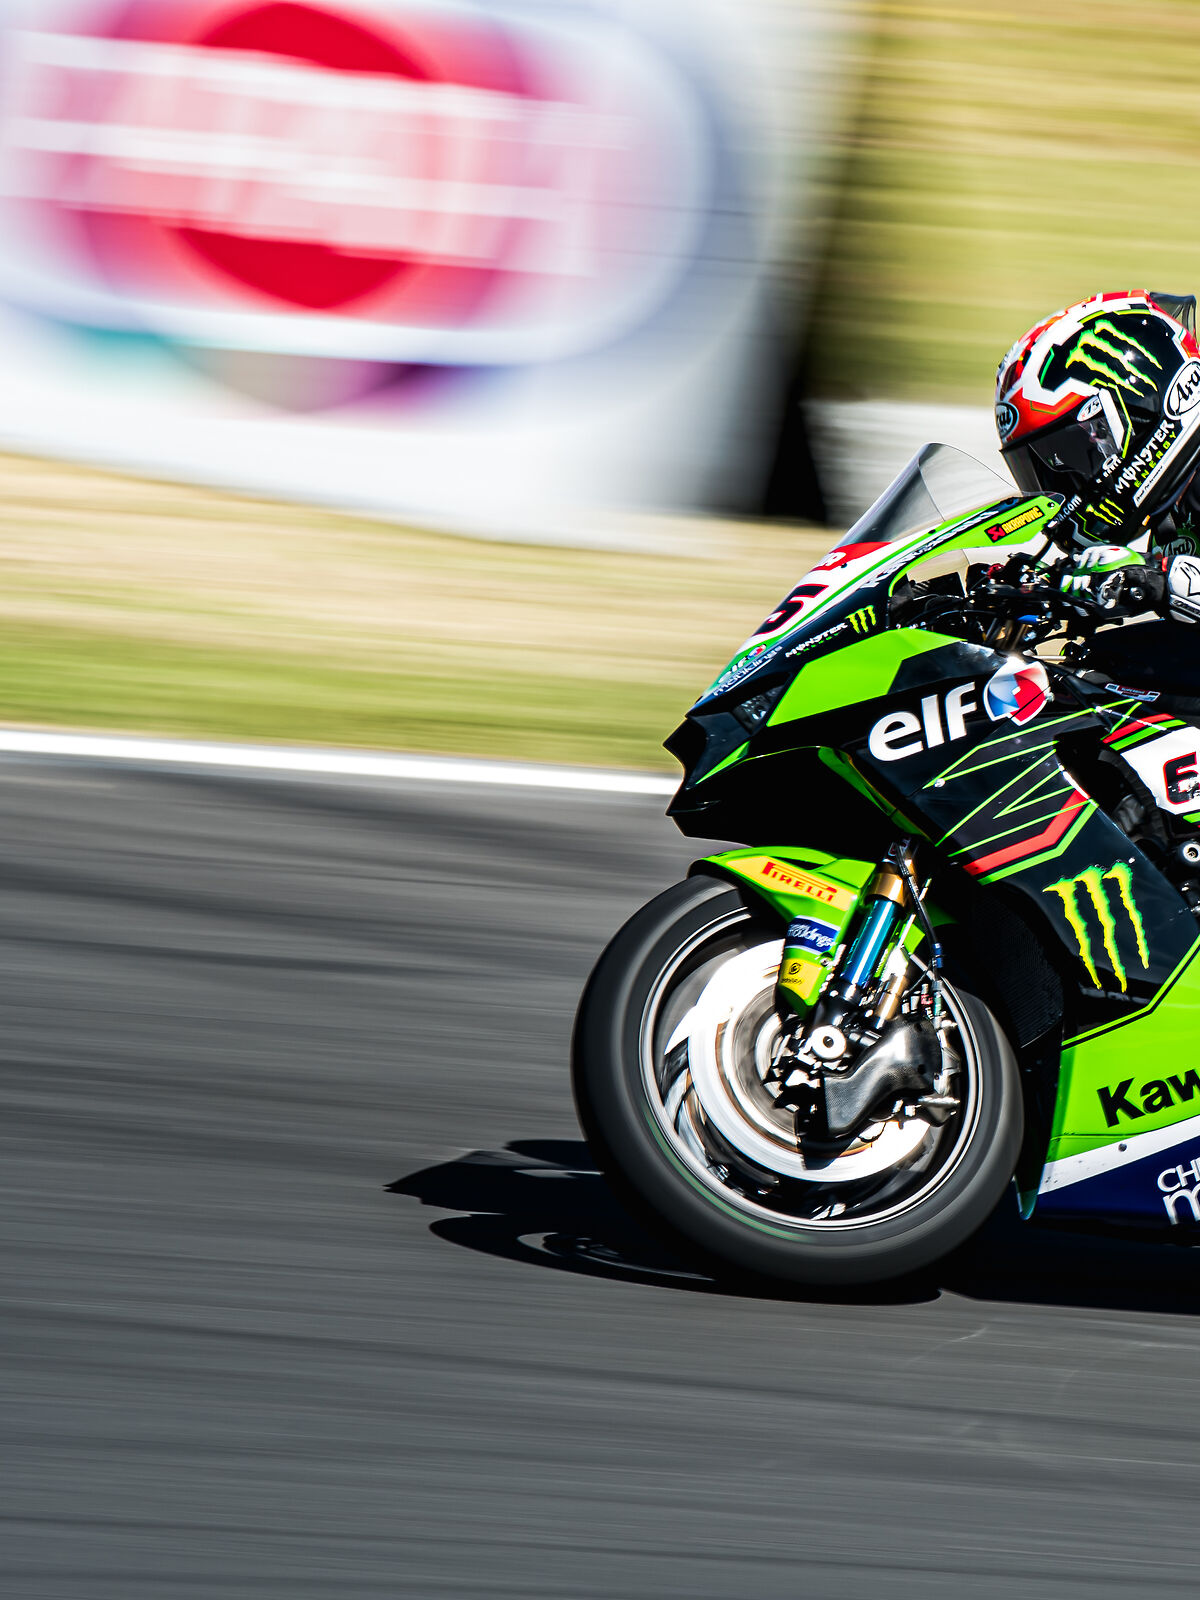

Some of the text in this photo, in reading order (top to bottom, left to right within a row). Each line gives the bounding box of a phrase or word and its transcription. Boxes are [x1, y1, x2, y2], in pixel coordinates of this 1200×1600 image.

[1114, 420, 1175, 494] MONSTER
[1134, 431, 1177, 488] ENERGY
[785, 622, 849, 658] MONSTER
[868, 681, 978, 762] elf
[760, 861, 838, 902] PIRELLI
